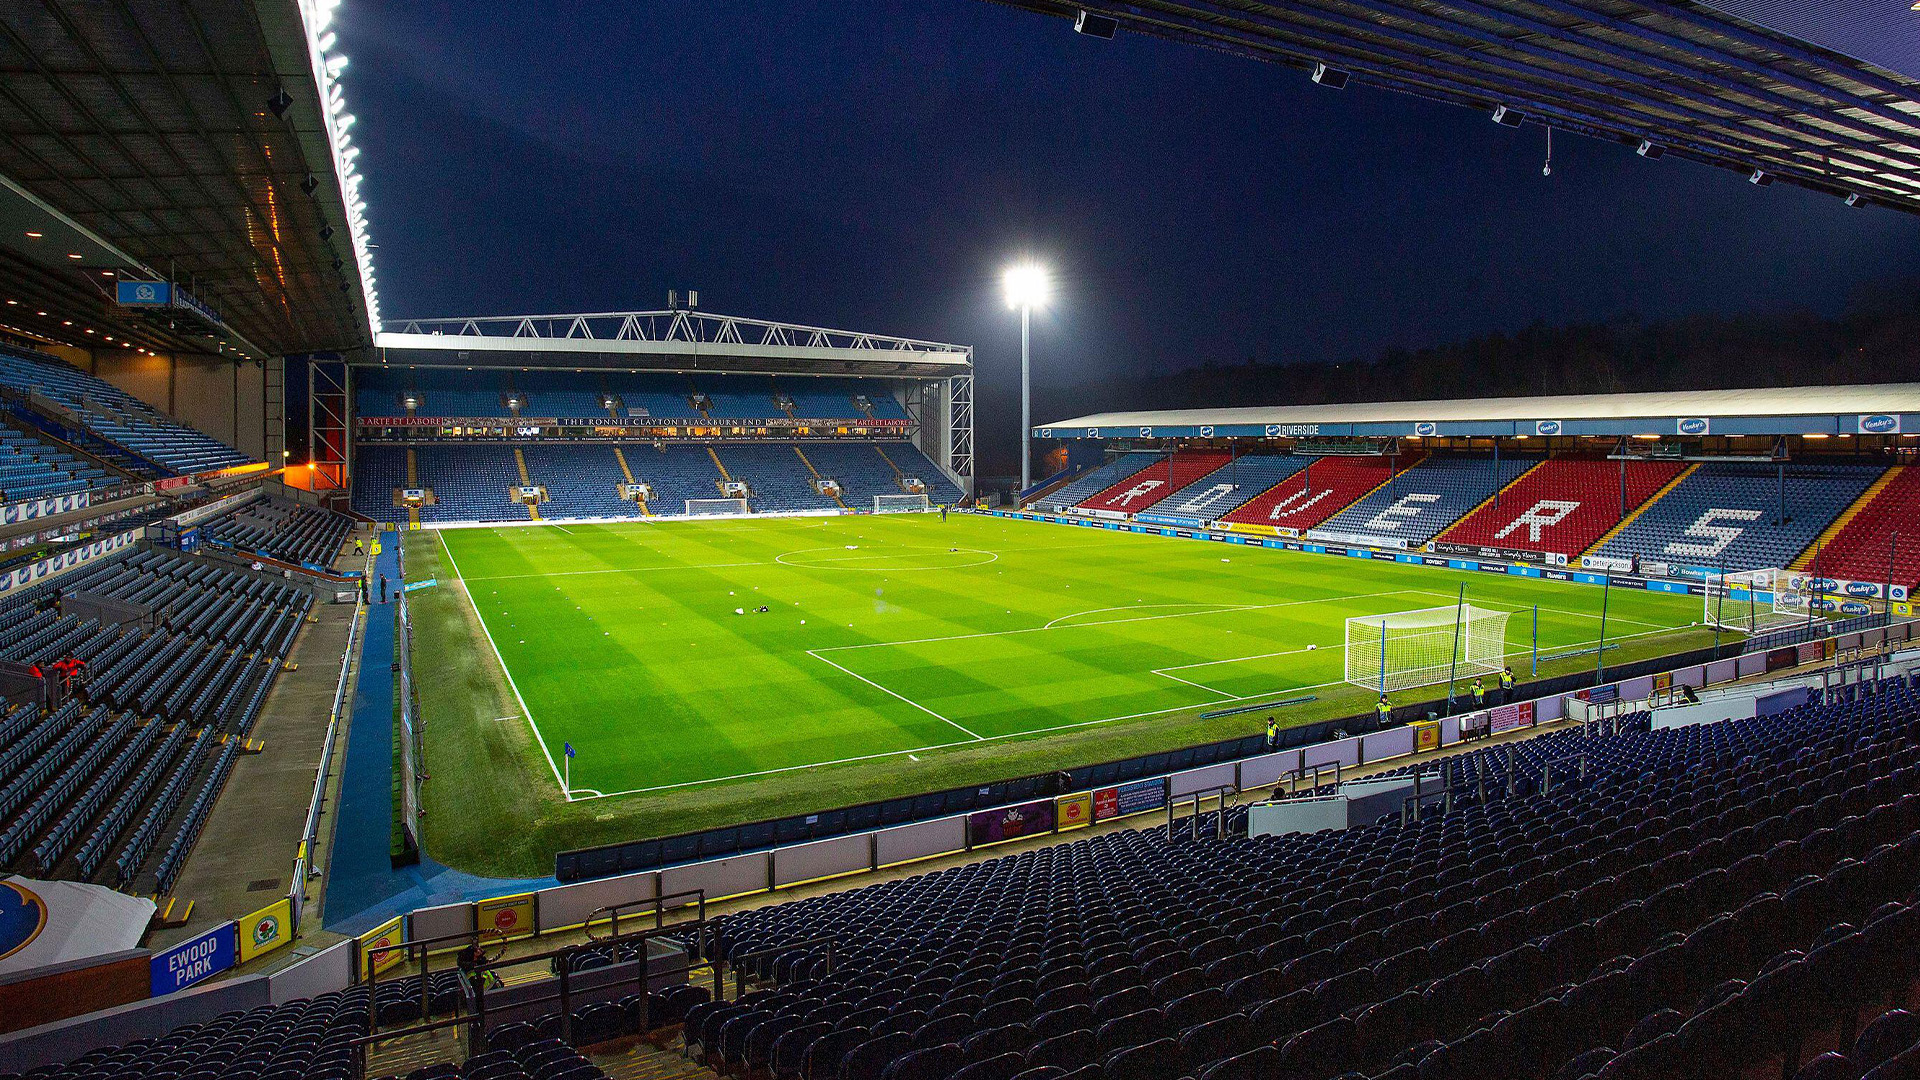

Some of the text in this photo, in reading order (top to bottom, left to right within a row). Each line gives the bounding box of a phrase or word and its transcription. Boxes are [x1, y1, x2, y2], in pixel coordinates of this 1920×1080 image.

[367, 417, 441, 426] ARTE ET LABORE
[565, 418, 761, 426] THE RONNIE CLAYTON BLACKBURN END
[1681, 420, 1705, 431] Venky's
[1866, 418, 1892, 429] Venky's
[1282, 425, 1319, 435] RIVERSIDE
[1437, 543, 1469, 553] Simply Floors
[1502, 550, 1538, 560] Simply Floors
[1681, 568, 1704, 577] Bowker
[1848, 583, 1876, 595] Venky's
[1842, 603, 1866, 613] Venky's
[169, 937, 217, 973] EWOOD
[176, 955, 212, 986] PARK
